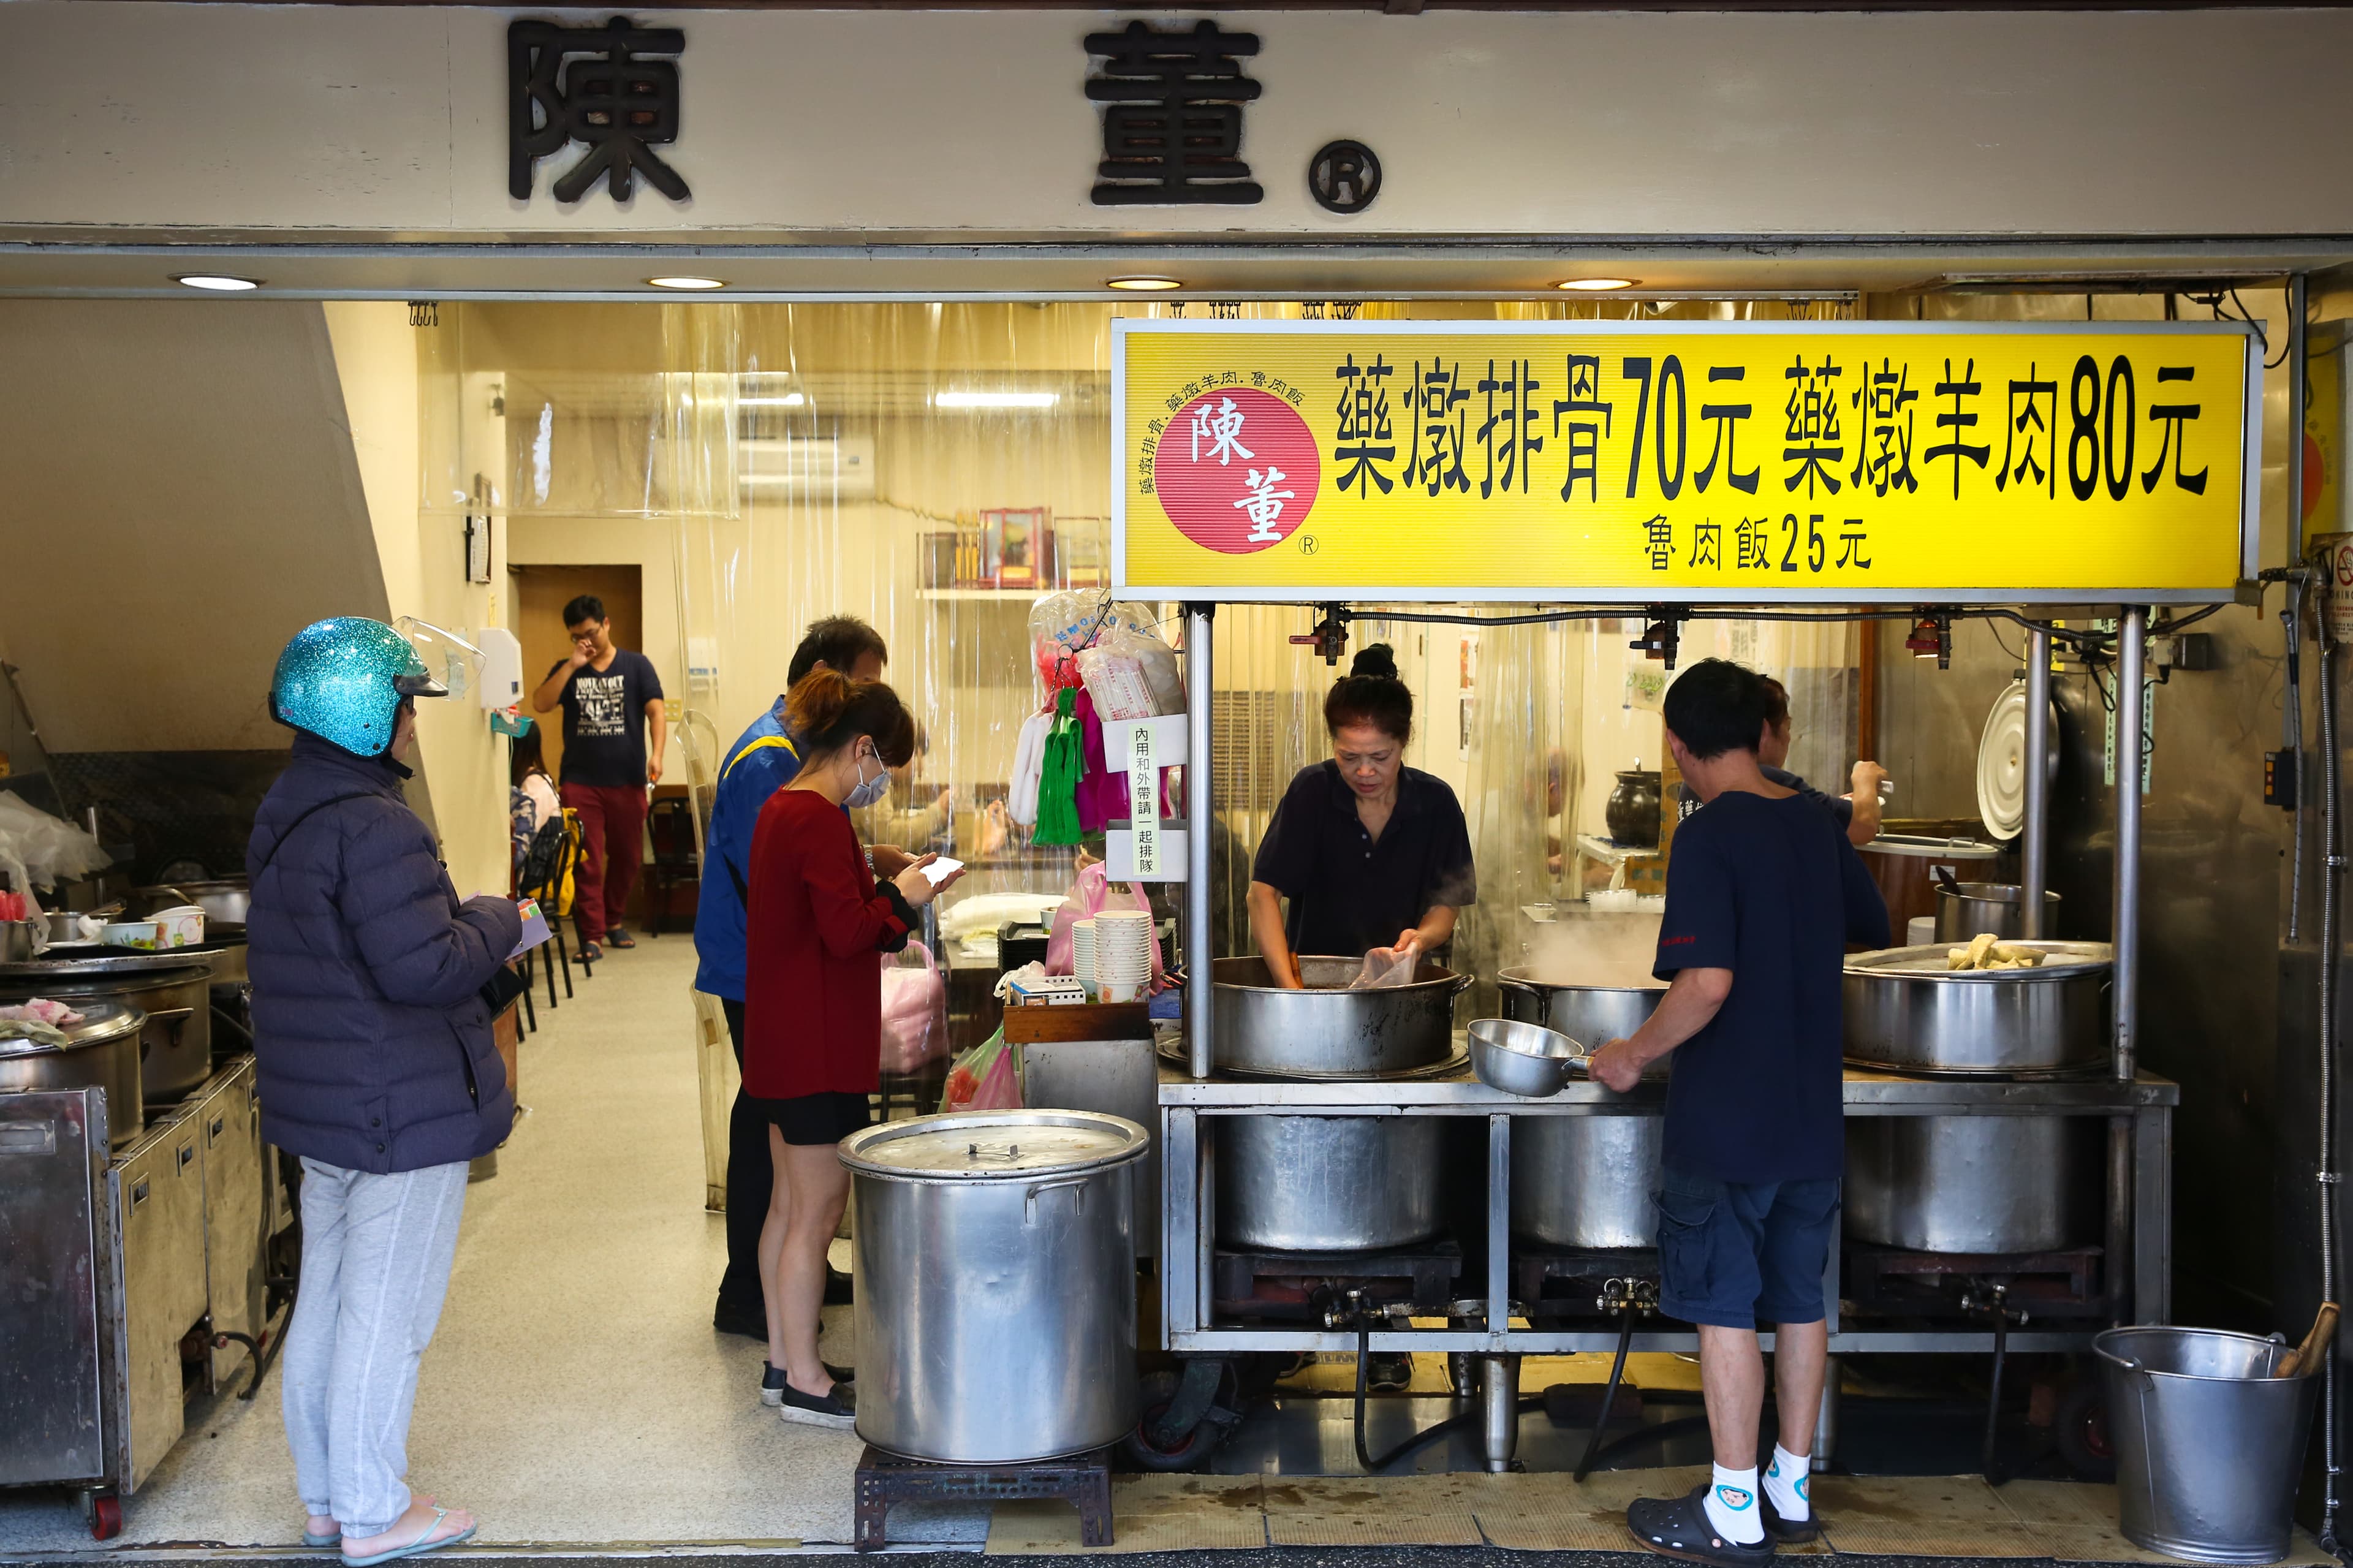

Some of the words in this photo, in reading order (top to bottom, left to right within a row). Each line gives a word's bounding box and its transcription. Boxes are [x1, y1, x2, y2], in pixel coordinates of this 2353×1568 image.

[507, 15, 692, 203] 陳
[1083, 18, 1264, 205] 董
[1334, 353, 1760, 502] 藥燉排骨70元
[1783, 354, 2208, 501] 藥燉羊肉80元
[1642, 513, 1871, 573] 魯肉飯25元
[1135, 727, 1154, 873] 內用和外帶請一起排隊
